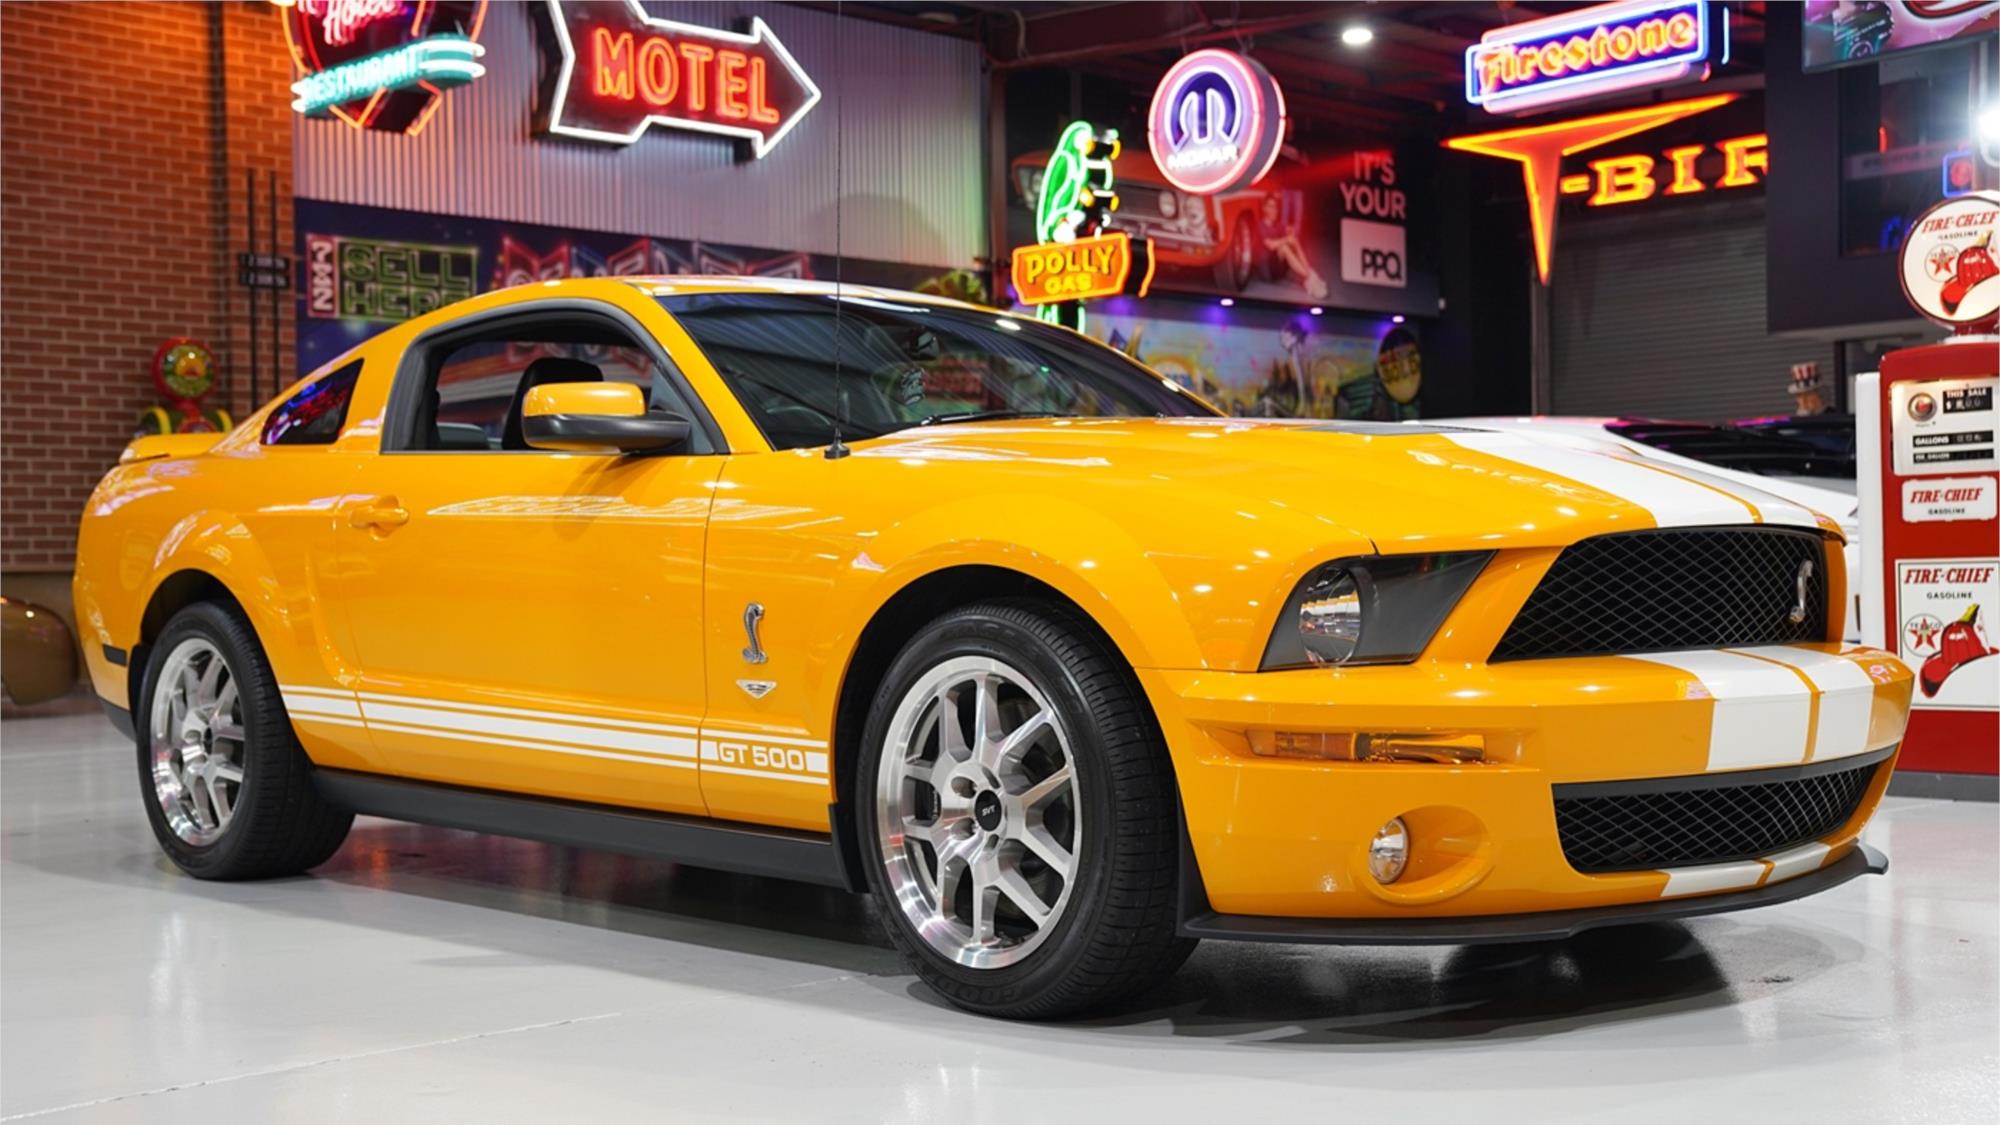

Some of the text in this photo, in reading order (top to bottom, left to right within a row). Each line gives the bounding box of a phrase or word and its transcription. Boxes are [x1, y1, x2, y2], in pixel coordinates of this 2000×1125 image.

[1475, 12, 1698, 94] Firestone
[302, 44, 418, 104] RESTAURANT
[594, 27, 780, 124] MOTEL
[1353, 151, 1395, 185] IT'S
[1340, 182, 1406, 219] YOUR
[343, 245, 472, 292] SELL
[1025, 243, 1115, 284] POLLY
[1361, 247, 1402, 280] PPQ
[1044, 272, 1092, 294] GAS
[1945, 387, 1987, 399] THIS SALE
[1914, 435, 1950, 445] GALLONS
[1928, 507, 1966, 515] GASOLINE
[1926, 591, 1973, 600] GASOLINE
[719, 741, 805, 771] GT 500
[981, 805, 996, 817] SVT
